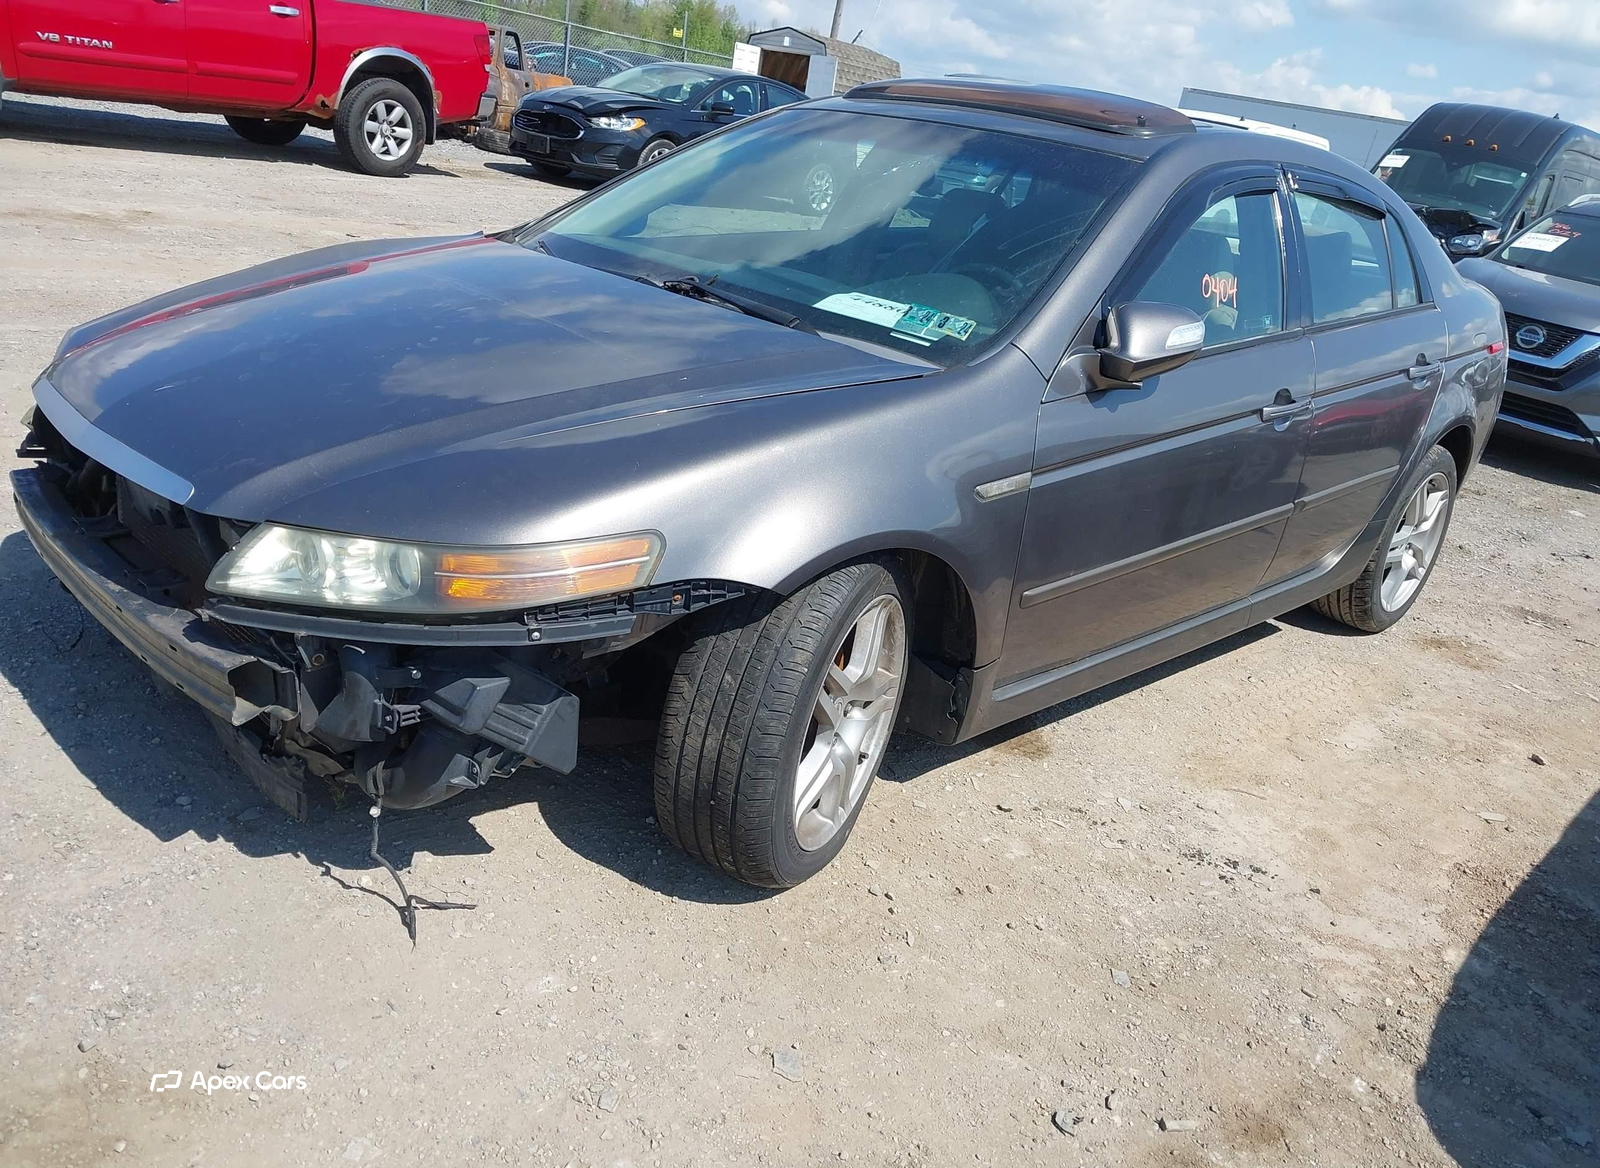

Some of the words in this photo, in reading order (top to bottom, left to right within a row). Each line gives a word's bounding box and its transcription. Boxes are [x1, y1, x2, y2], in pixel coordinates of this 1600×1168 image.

[64, 35, 113, 49] TITAN
[1202, 273, 1238, 308] 0404
[920, 311, 935, 323] 24
[938, 316, 950, 328] 3
[957, 322, 972, 336] 24
[1518, 332, 1542, 342] NISSAN
